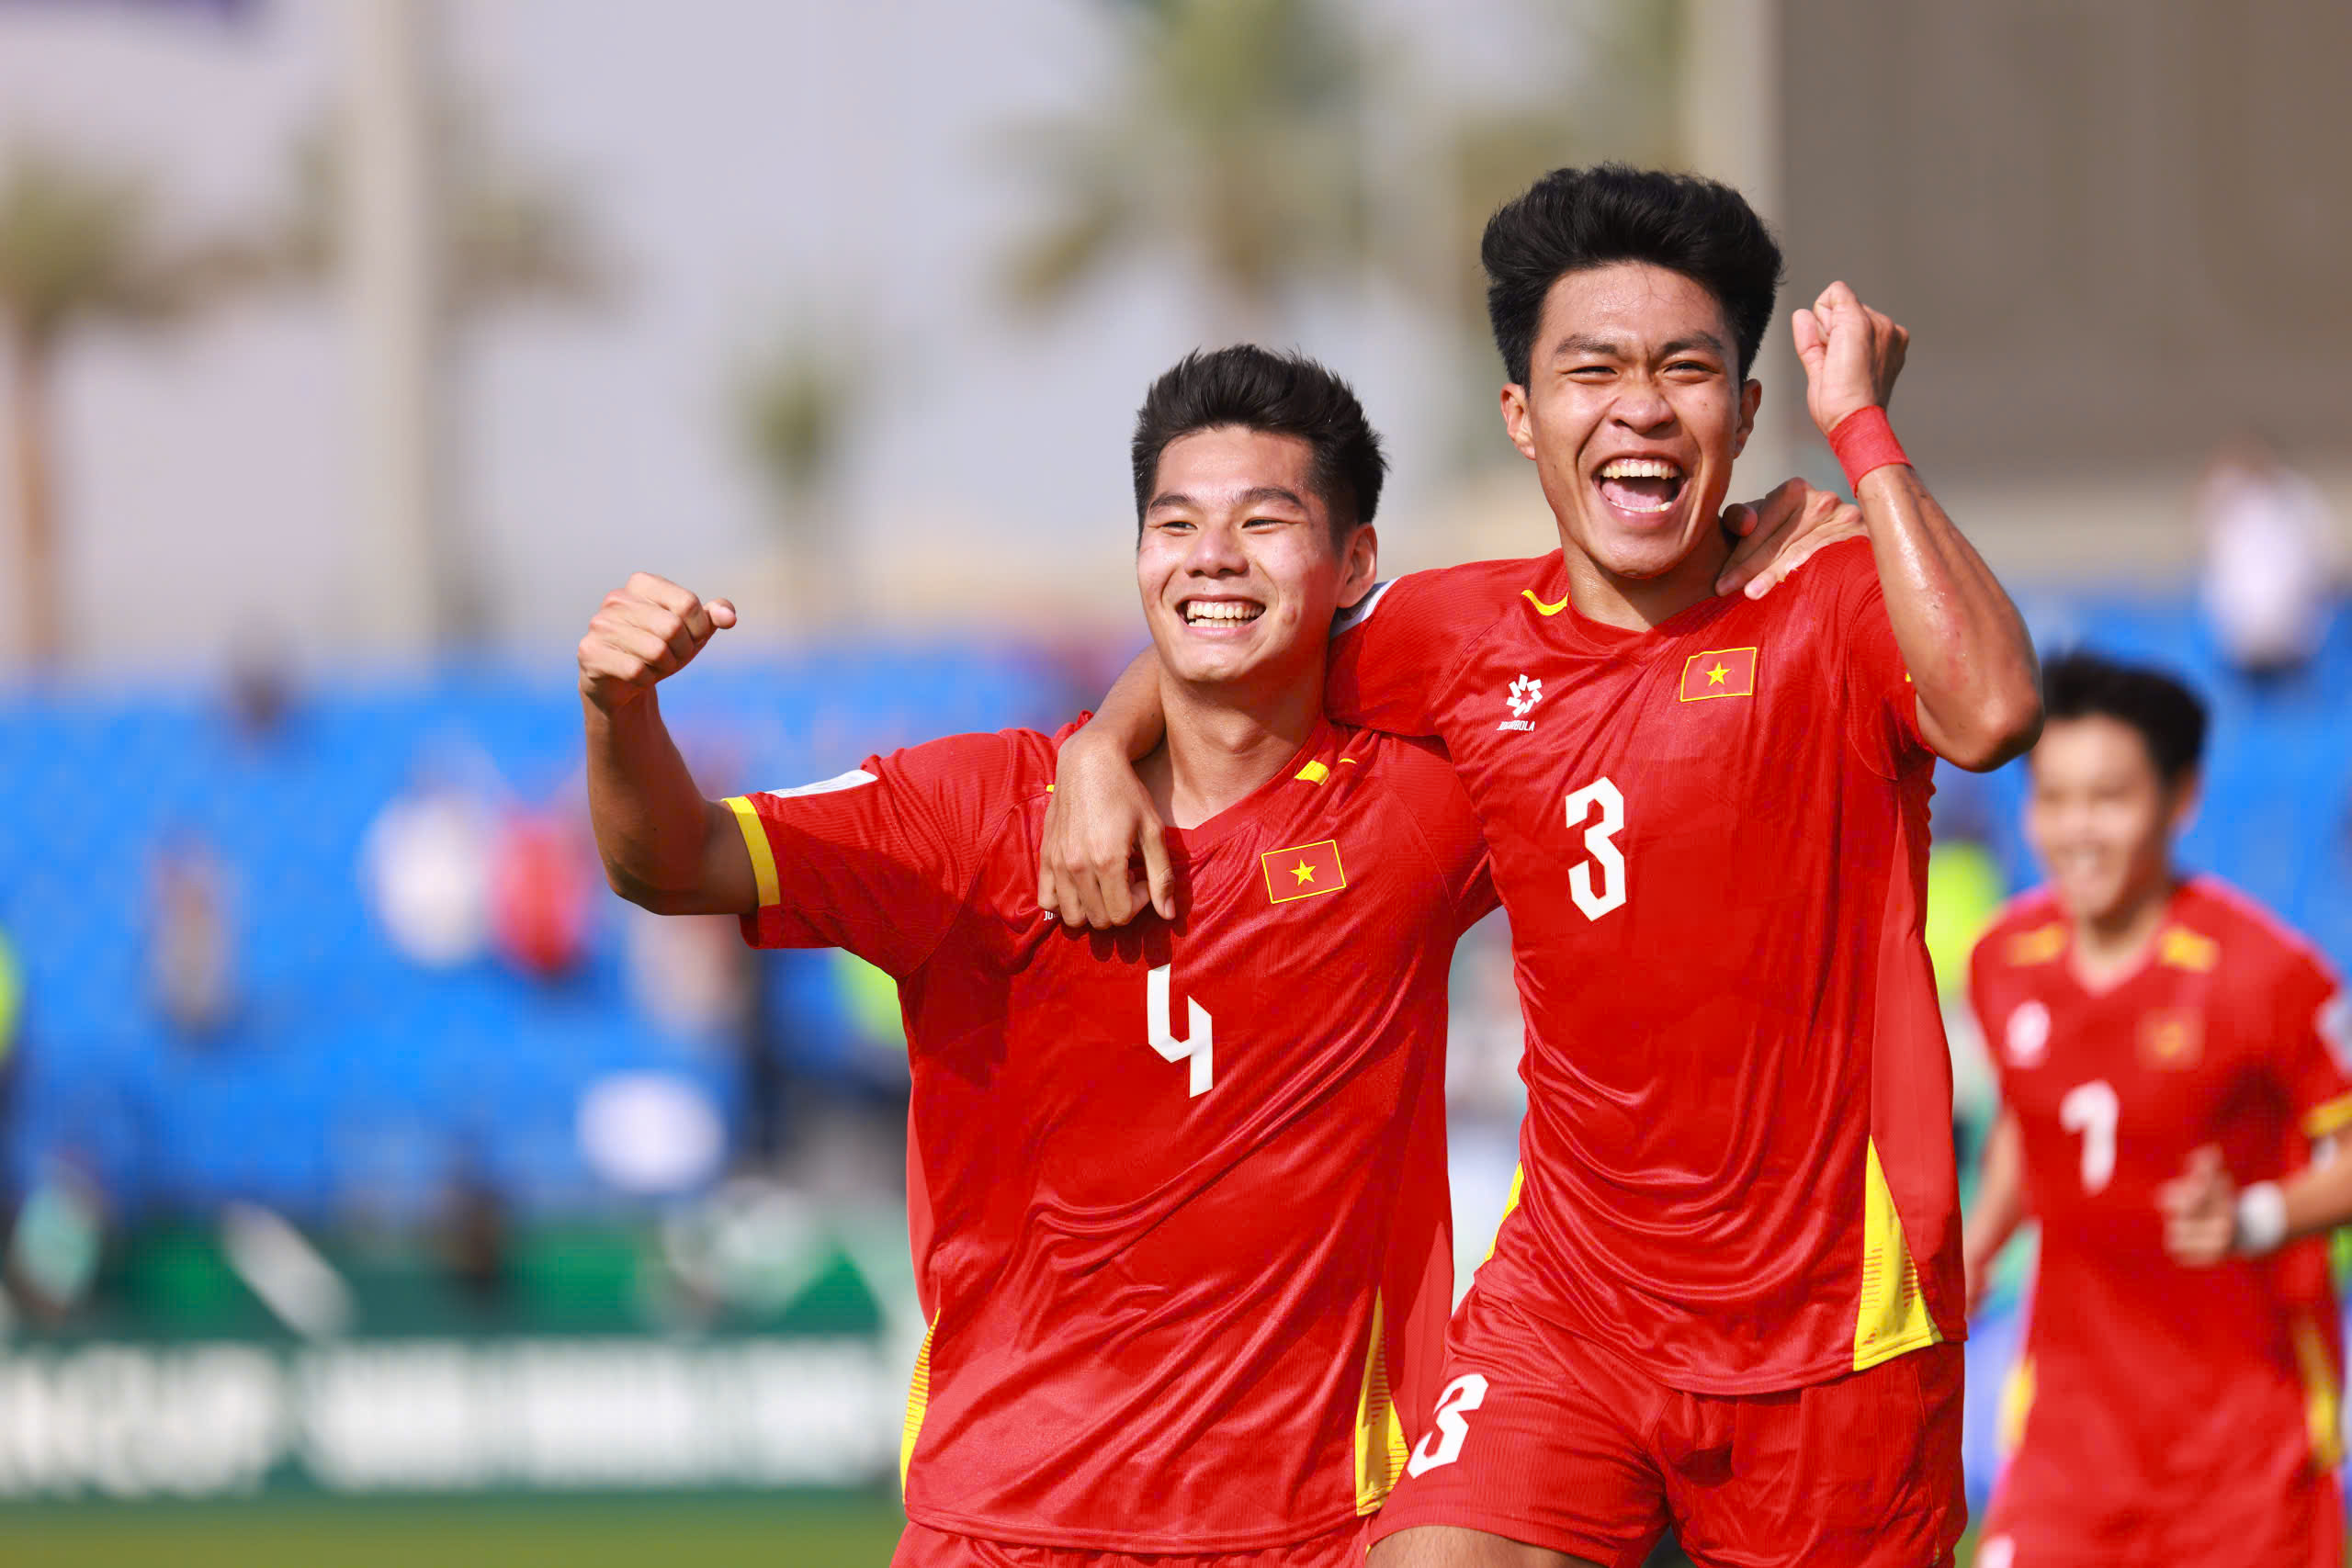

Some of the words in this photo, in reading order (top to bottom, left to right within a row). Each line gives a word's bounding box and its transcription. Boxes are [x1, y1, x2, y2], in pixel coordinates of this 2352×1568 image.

[1565, 776, 1626, 921] 3
[1148, 963, 1213, 1098] 4
[1407, 1373, 1489, 1480] 3
